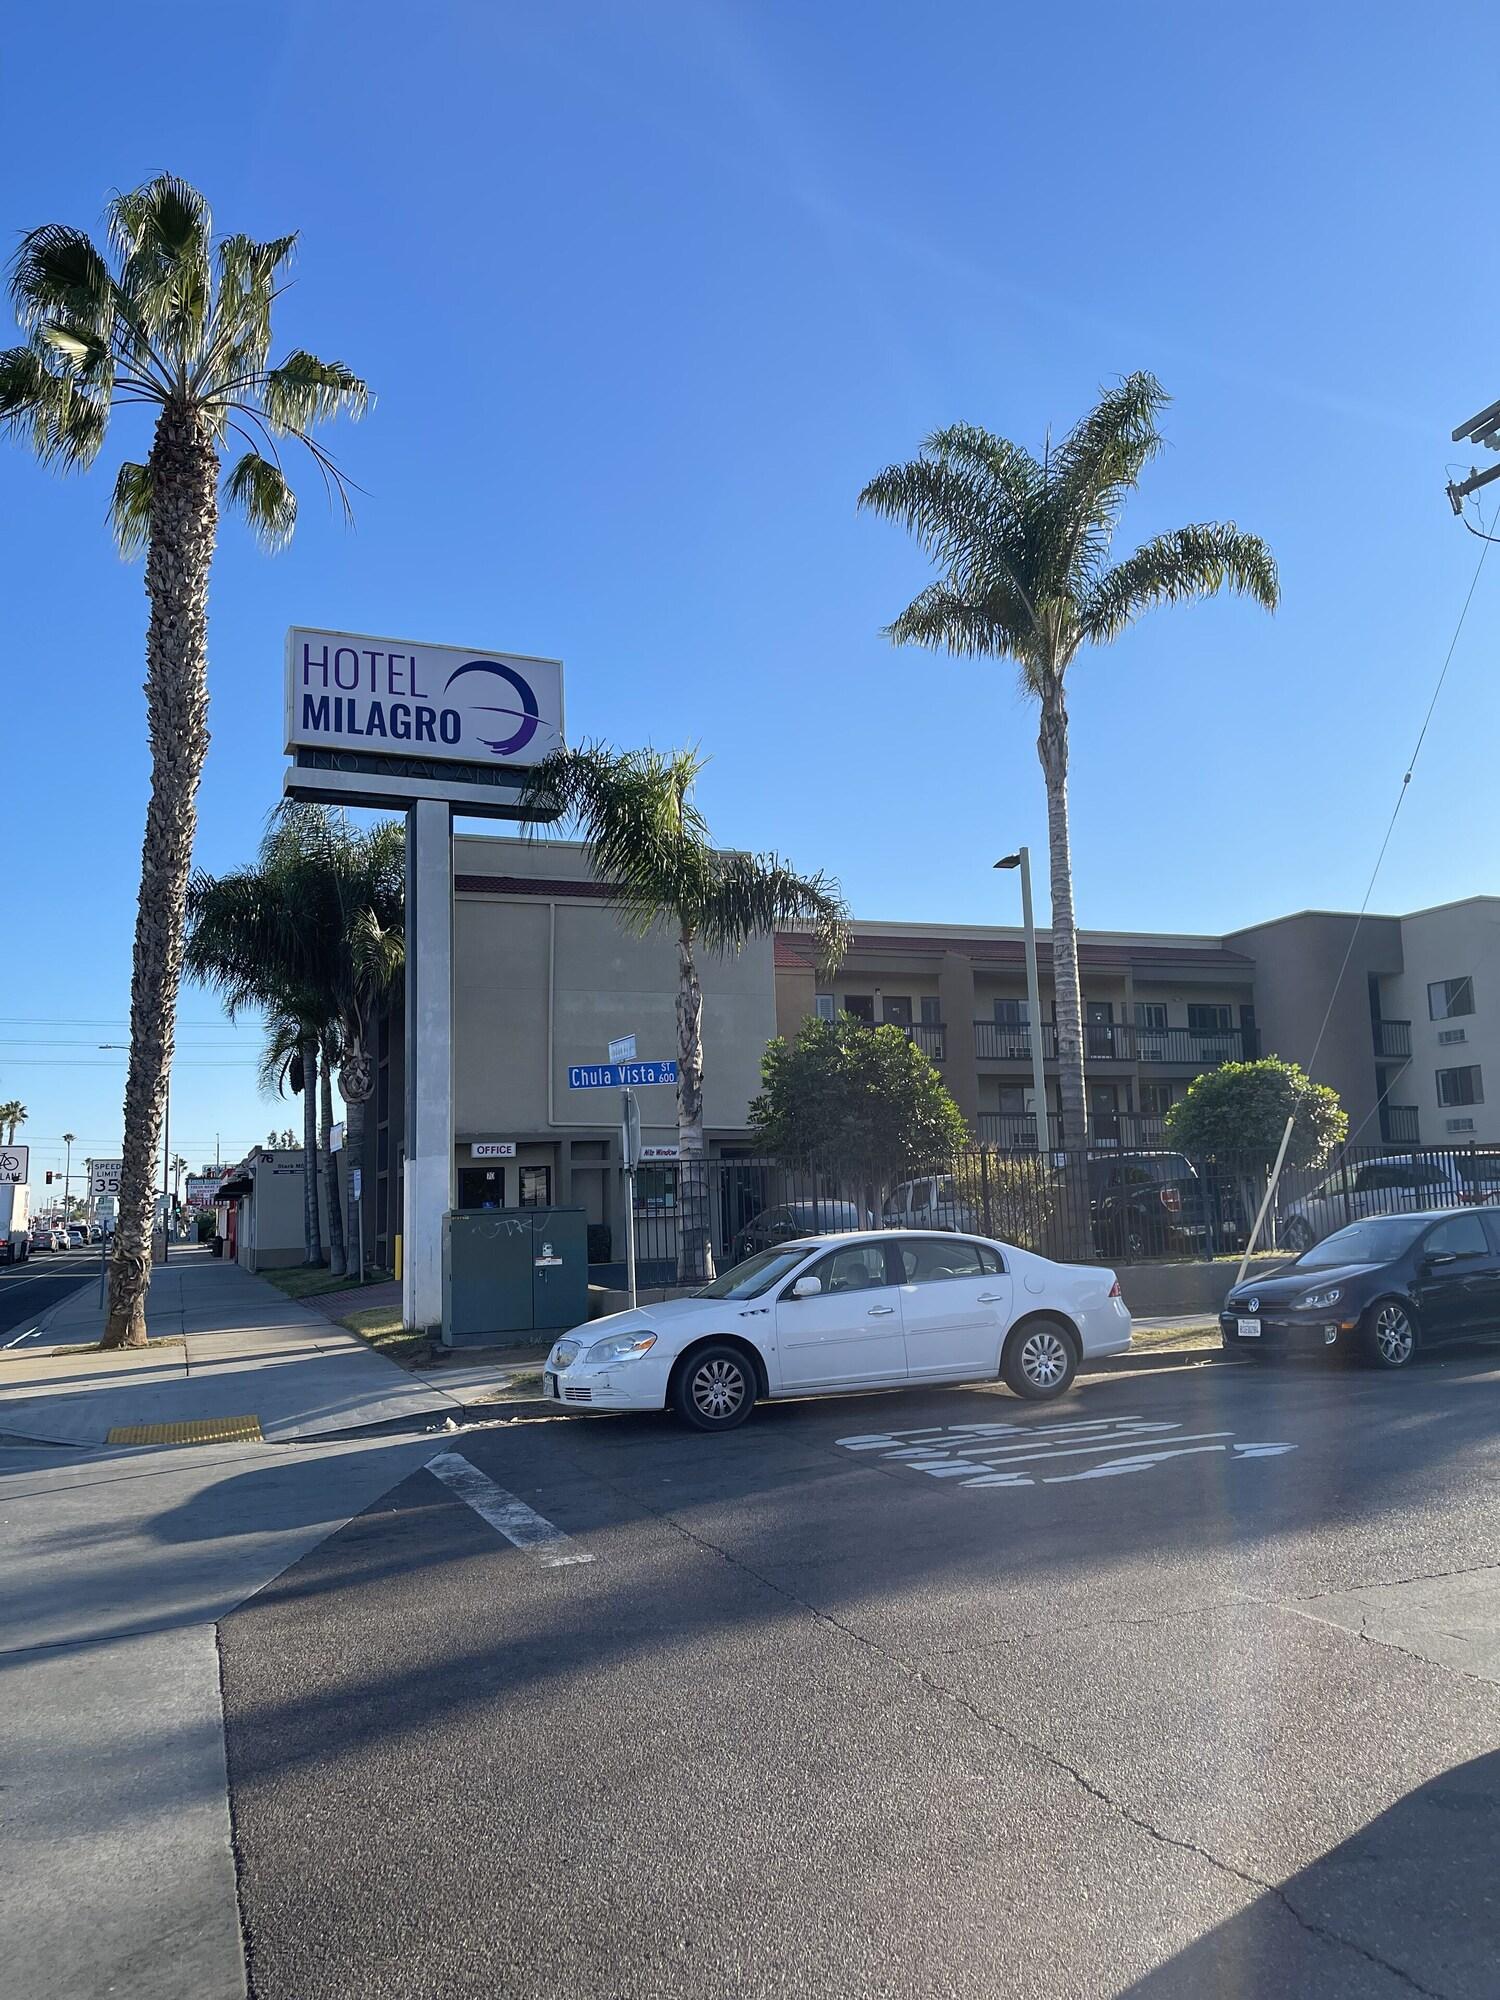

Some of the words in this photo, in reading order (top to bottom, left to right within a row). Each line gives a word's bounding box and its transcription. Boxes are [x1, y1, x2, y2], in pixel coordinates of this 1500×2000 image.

[303, 643, 428, 699] HOTEL
[302, 693, 462, 745] MILAGRO
[311, 753, 359, 772] NO
[383, 758, 514, 786] VACANC
[572, 1068, 612, 1087] Chula
[617, 1065, 655, 1085] Vista
[660, 1062, 671, 1072] ST
[659, 1073, 675, 1083] 600
[260, 1153, 274, 1163] 76
[476, 1145, 512, 1155] OFFICE
[656, 1148, 678, 1157] Window
[95, 1179, 119, 1192] 35
[834, 1414, 1299, 1489] STOP
